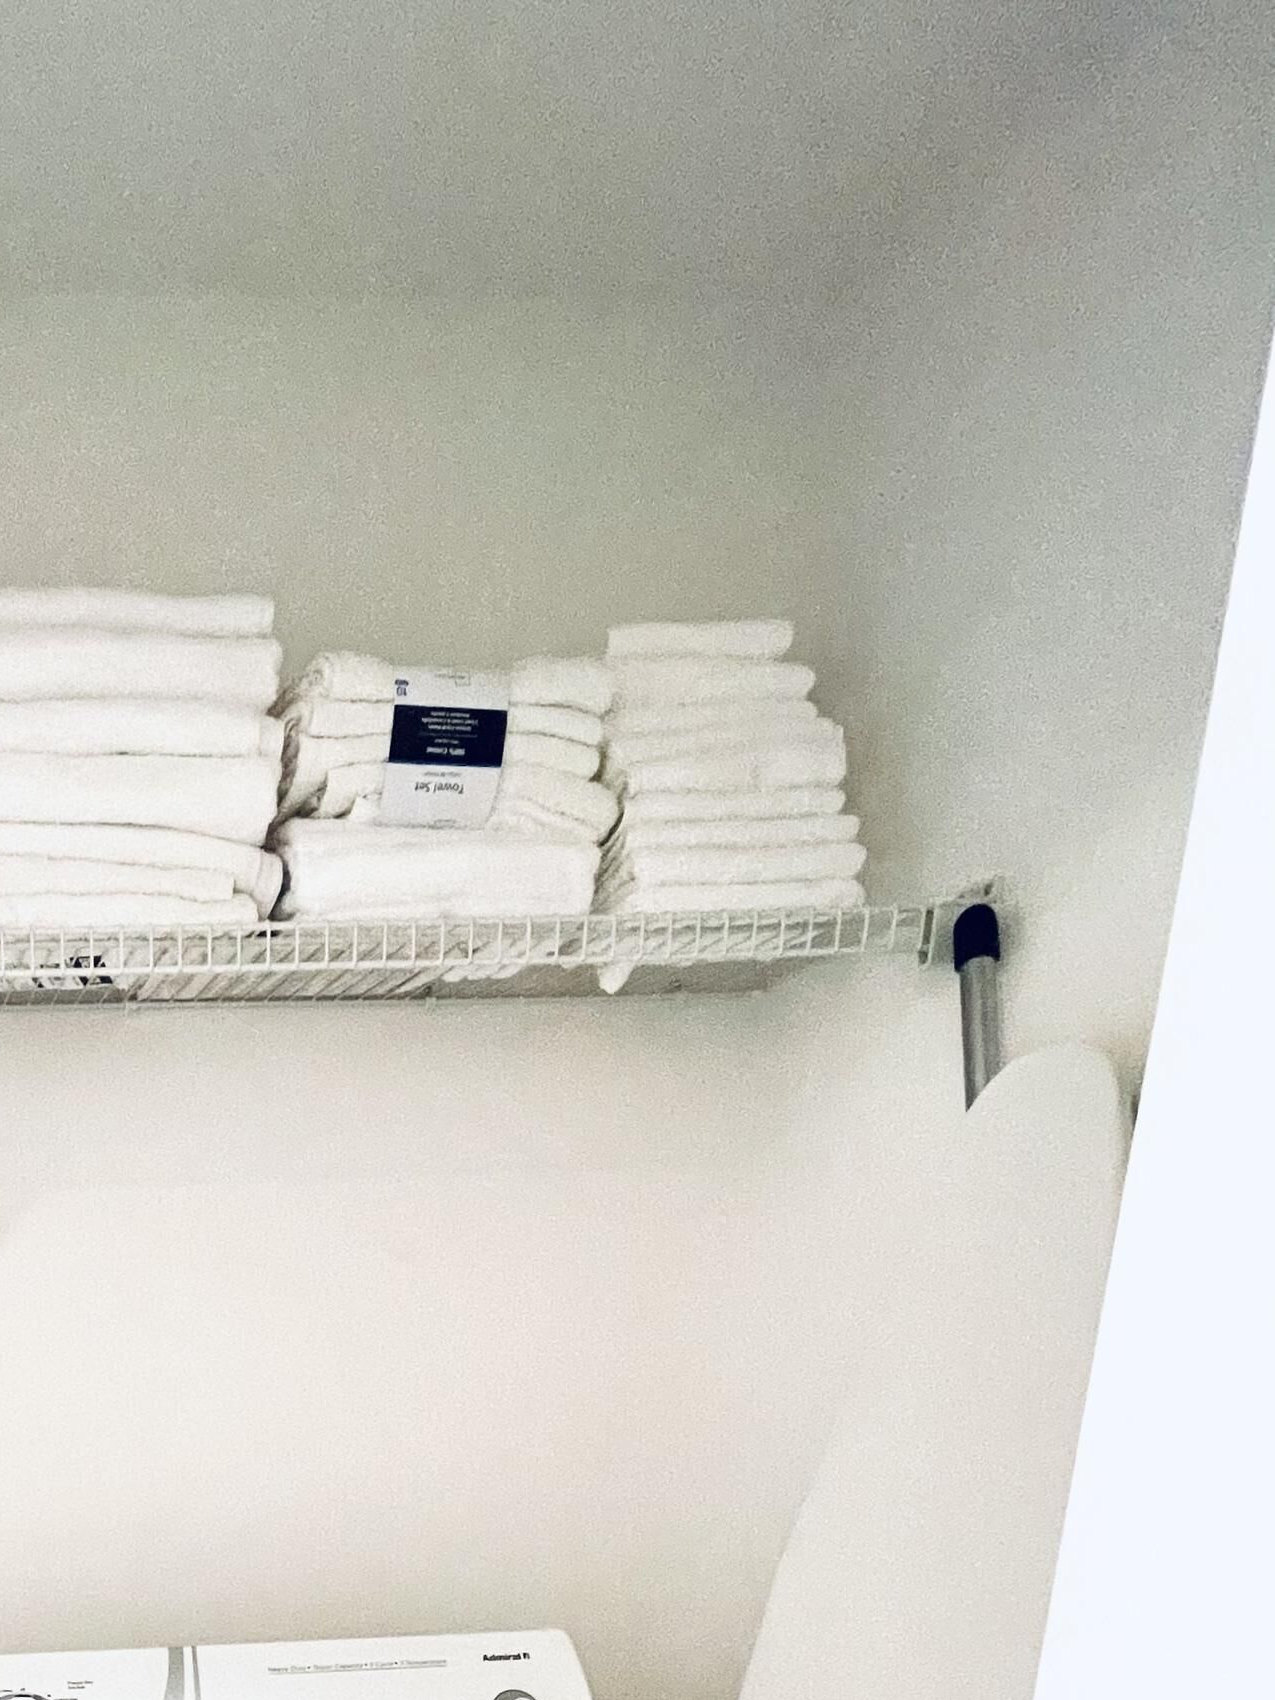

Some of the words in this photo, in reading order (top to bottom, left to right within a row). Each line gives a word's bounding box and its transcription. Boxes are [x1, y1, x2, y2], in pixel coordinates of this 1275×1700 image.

[414, 782, 431, 793] Set
[433, 782, 464, 794] Towel
[482, 1652, 522, 1662] Admiral
